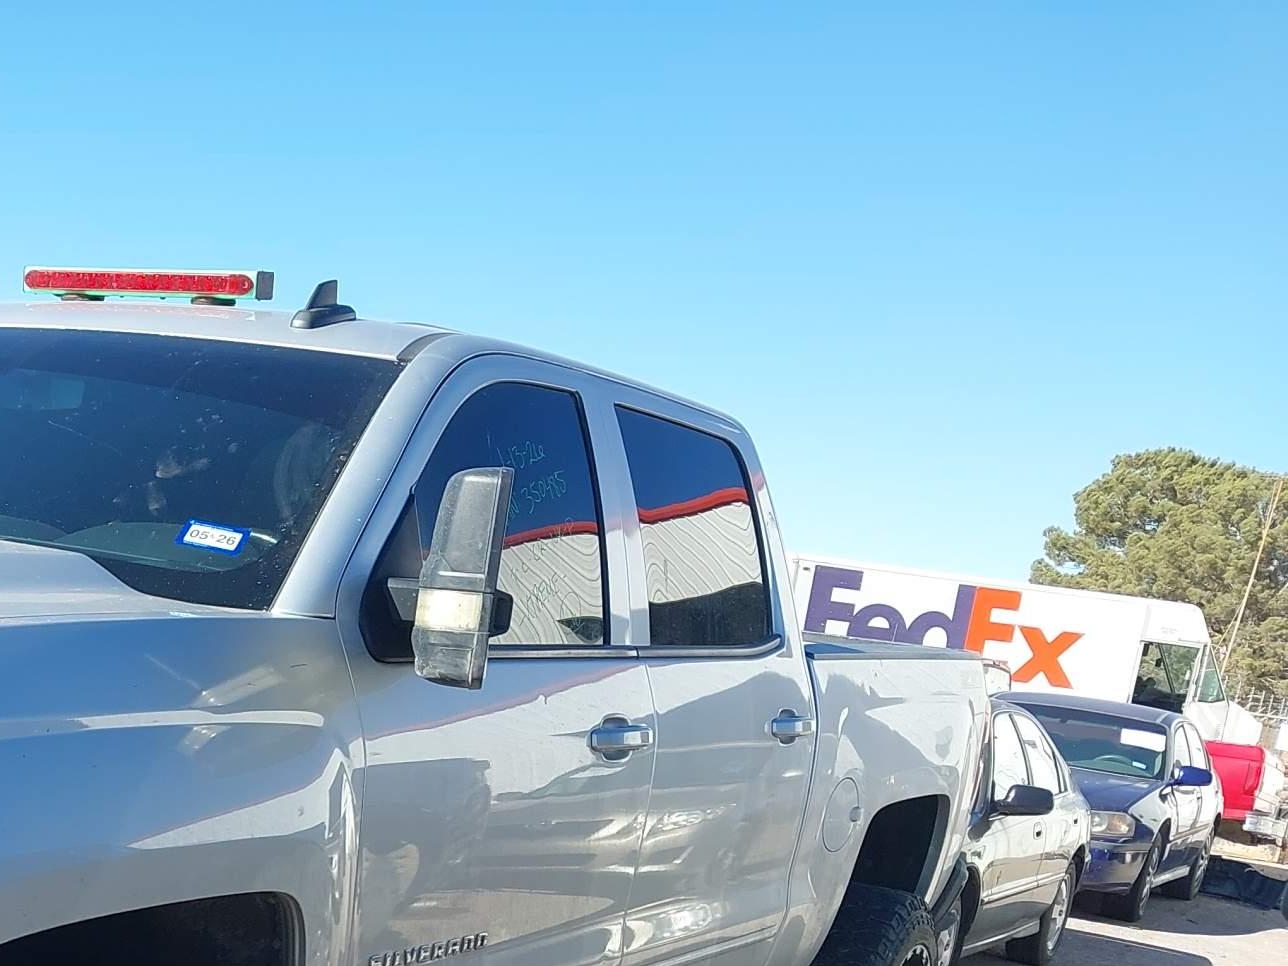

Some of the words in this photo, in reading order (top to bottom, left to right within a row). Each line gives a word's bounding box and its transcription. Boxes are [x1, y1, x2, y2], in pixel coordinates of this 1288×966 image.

[189, 529, 210, 540] 05
[216, 534, 237, 546] 26
[804, 564, 1085, 689] FedEx
